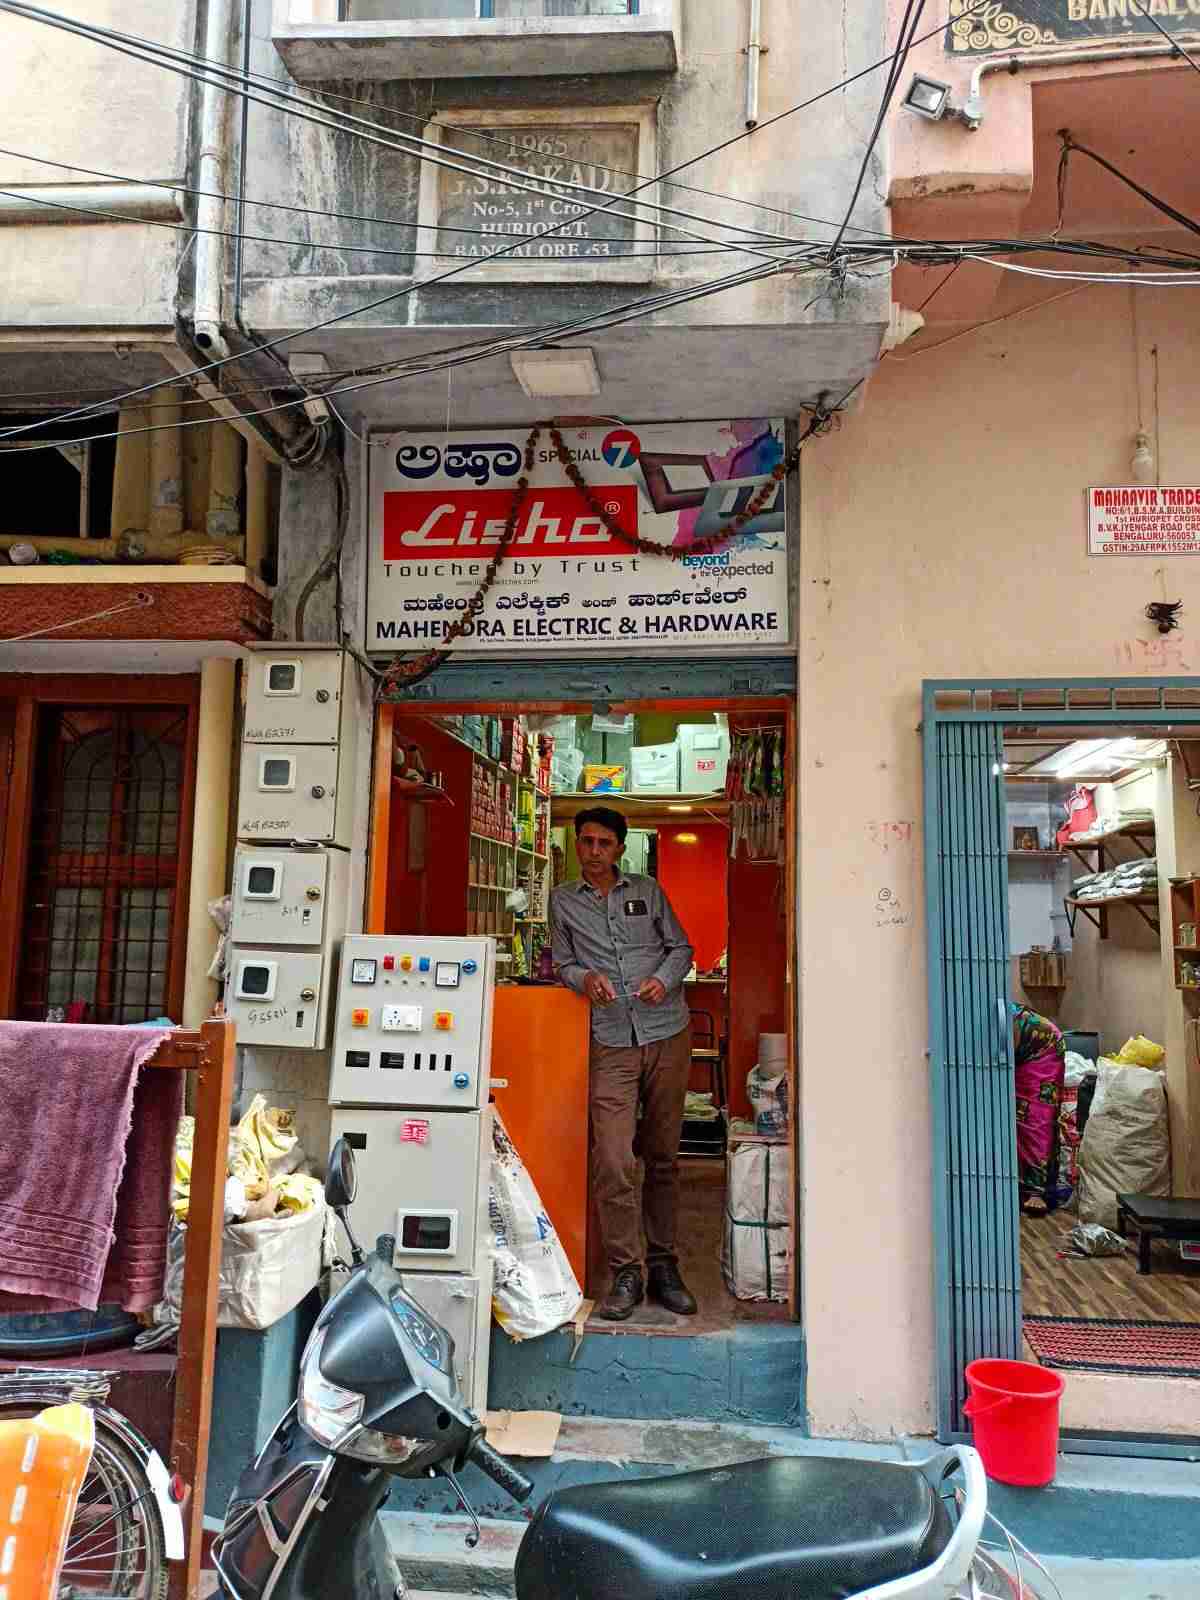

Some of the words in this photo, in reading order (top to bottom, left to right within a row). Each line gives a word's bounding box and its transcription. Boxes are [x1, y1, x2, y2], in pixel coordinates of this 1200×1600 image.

[396, 441, 521, 486] ಲಿಷಾ
[539, 448, 600, 463] SPCIAL
[401, 501, 614, 547] Lisha
[1160, 523, 1183, 531] ROAD
[384, 562, 496, 577] Touche
[514, 561, 542, 577] by
[560, 560, 640, 573] Trust
[682, 552, 729, 568] beyond
[711, 561, 774, 579] expected
[513, 616, 611, 636] ELECTRIC
[618, 617, 637, 634] &
[645, 612, 778, 633] HARDWARE
